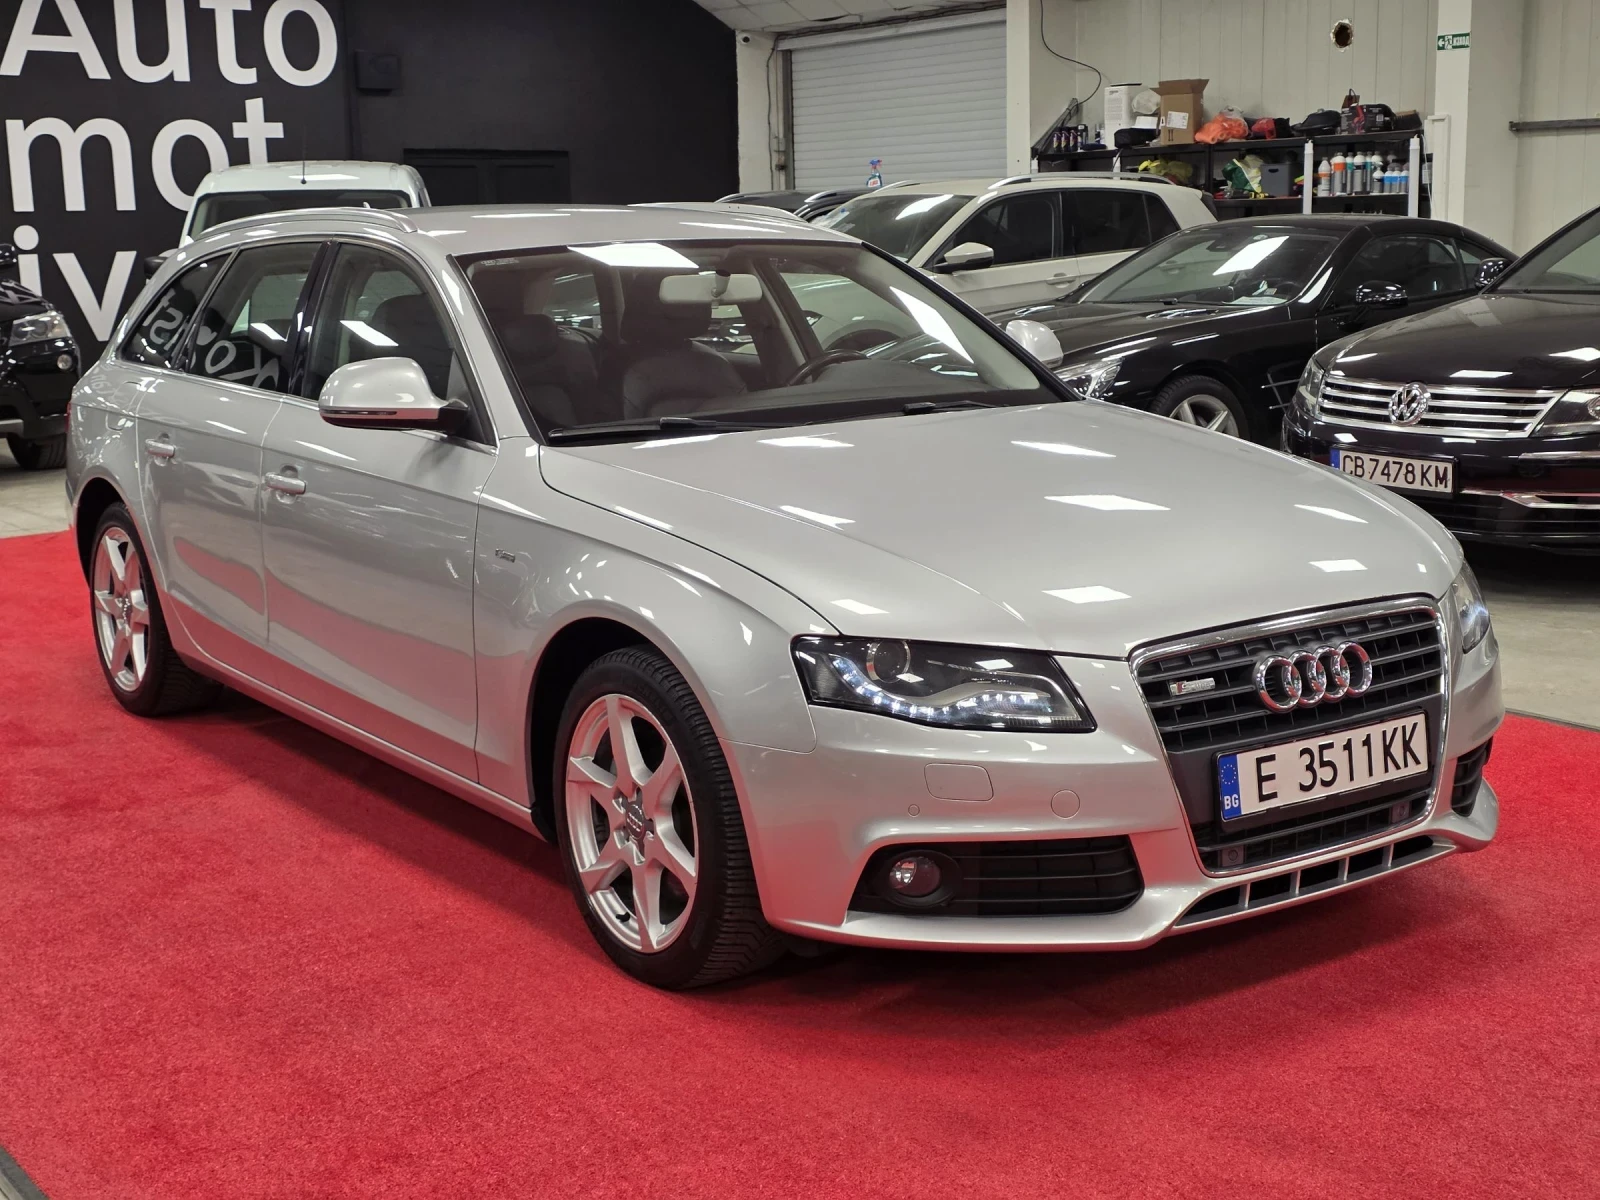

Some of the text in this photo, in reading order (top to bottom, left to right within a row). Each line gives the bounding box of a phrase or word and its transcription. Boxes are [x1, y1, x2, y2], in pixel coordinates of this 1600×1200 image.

[0, 0, 337, 87] Auto
[13, 225, 172, 342] iv
[1223, 794, 1240, 810] BG
[1255, 753, 1278, 803] E
